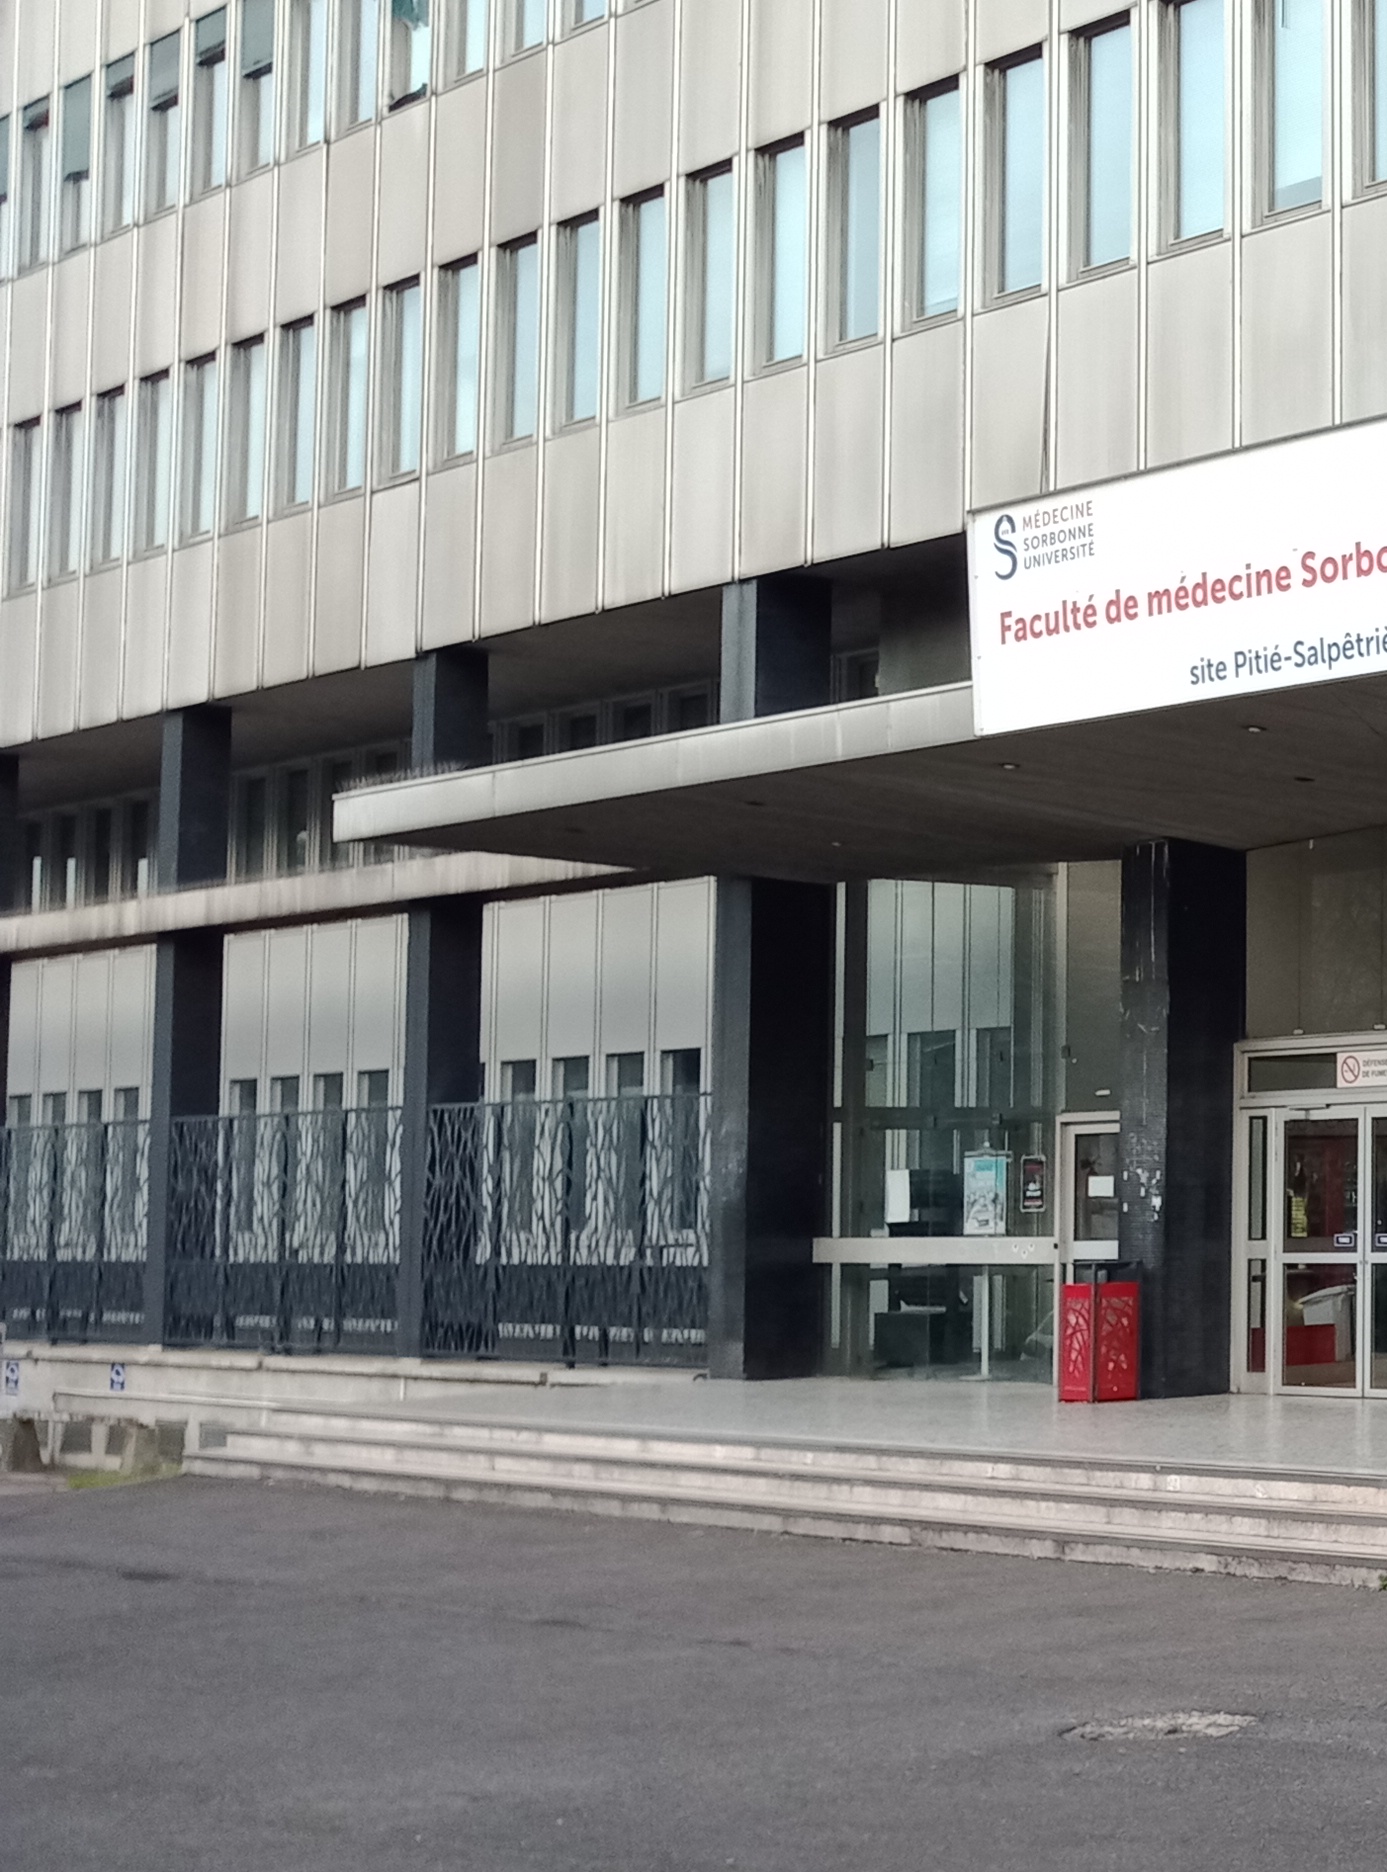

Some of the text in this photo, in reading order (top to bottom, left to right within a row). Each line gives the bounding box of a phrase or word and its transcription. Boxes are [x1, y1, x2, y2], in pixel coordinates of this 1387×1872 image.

[1022, 500, 1093, 532] MÉDECINE
[1023, 522, 1095, 552] SORBONNE
[1023, 538, 1095, 570] UNIVERSITÉ
[1000, 600, 1098, 645] Faculté
[1105, 588, 1139, 625] de
[1147, 565, 1292, 617] médecine
[1189, 658, 1228, 686] site
